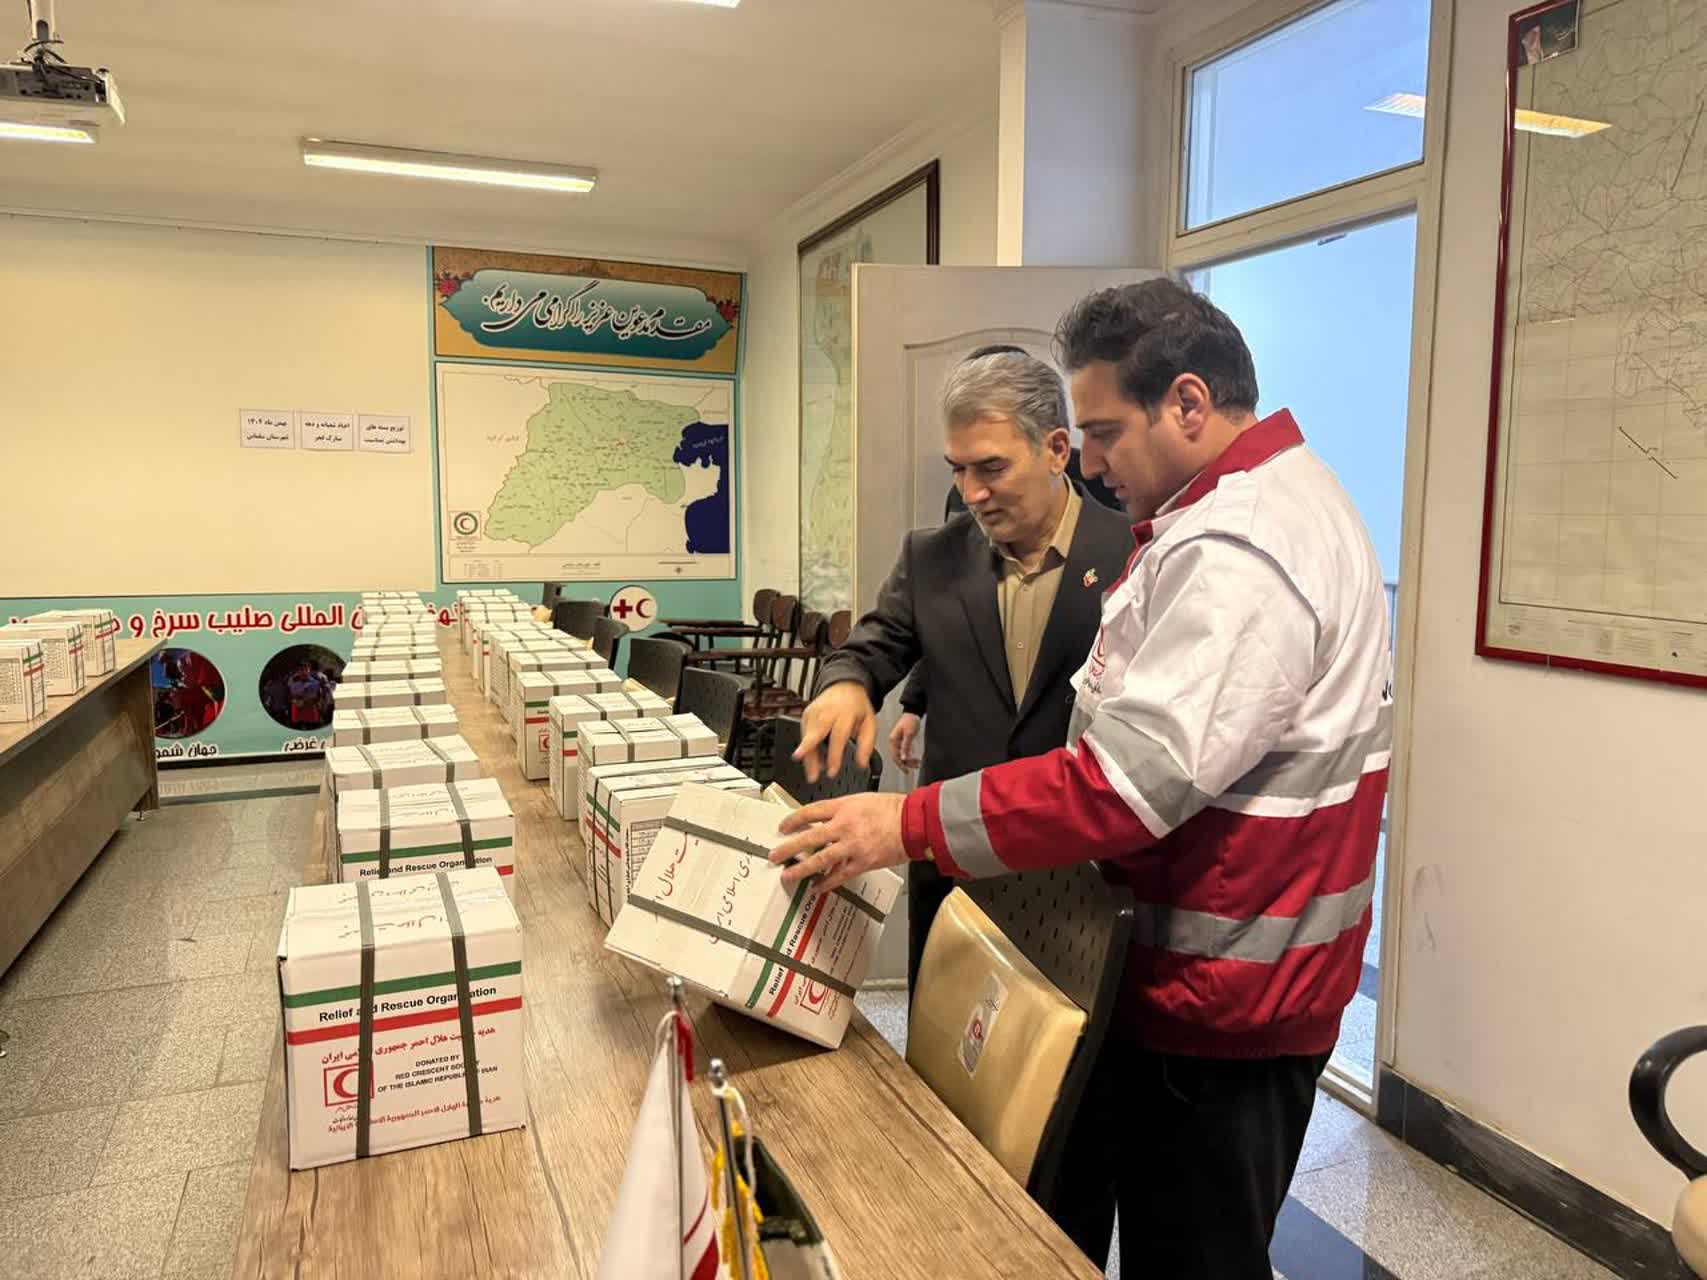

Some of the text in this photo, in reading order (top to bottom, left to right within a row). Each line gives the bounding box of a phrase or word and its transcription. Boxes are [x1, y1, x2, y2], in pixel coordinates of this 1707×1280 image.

[583, 300, 613, 334] عزیز
[130, 615, 144, 638] و
[151, 607, 200, 639] سرخ
[207, 607, 274, 634] صلیب
[281, 604, 343, 633] المللی
[188, 744, 217, 758] جهان
[788, 914, 806, 948] Rescue
[768, 967, 785, 996] Relief
[319, 986, 497, 1022] Relief ad Rescue Organation
[321, 1050, 344, 1065] ایران
[395, 1072, 411, 1080] RED
[411, 1063, 450, 1077] CRESCENT
[415, 1056, 449, 1067] DONATED
